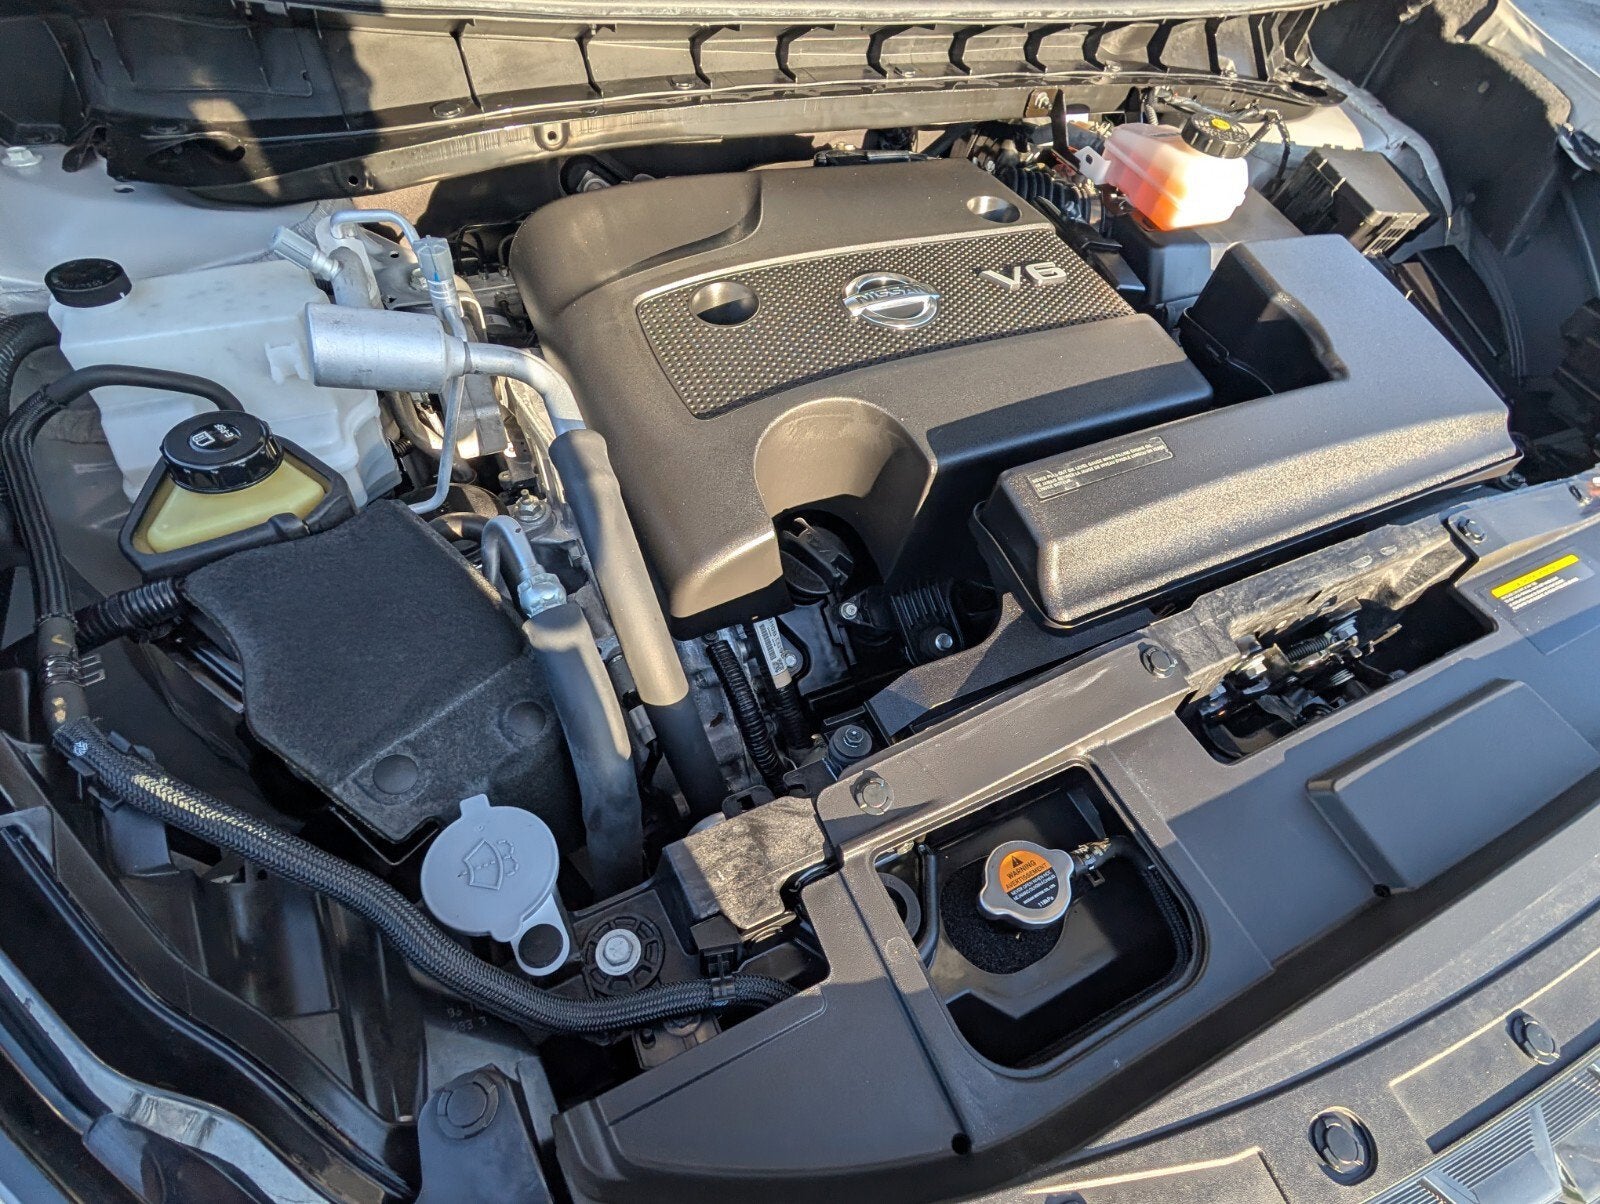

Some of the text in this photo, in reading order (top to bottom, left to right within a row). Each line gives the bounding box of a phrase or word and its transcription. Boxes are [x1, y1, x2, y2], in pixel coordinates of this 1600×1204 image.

[979, 261, 1067, 291] V6
[853, 283, 929, 304] NISSAN
[1006, 863, 1047, 889] AVERTISSEMENT
[1007, 860, 1036, 879] WARNING
